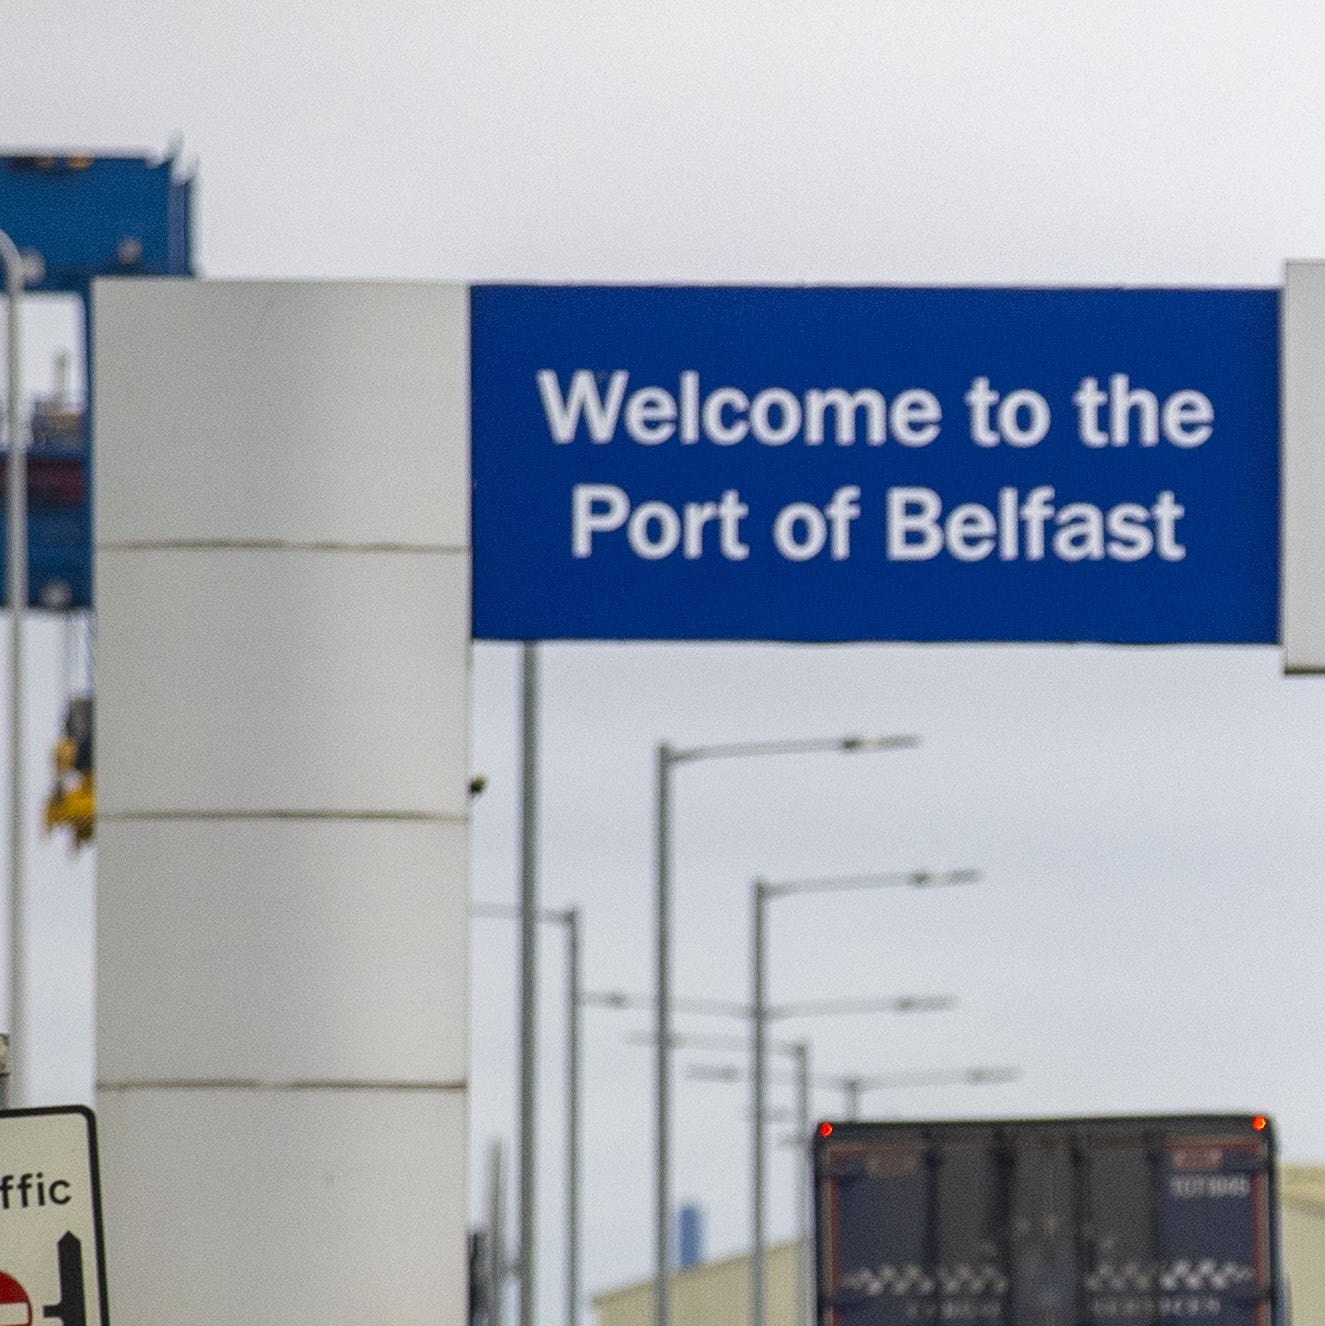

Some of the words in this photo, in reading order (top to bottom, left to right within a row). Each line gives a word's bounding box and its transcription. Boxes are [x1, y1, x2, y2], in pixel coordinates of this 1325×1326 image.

[538, 370, 941, 446] Welcome
[967, 377, 1050, 447] to
[1074, 374, 1214, 447] the
[573, 485, 749, 560] Port
[774, 486, 860, 560] of
[888, 486, 1185, 561] Belfast
